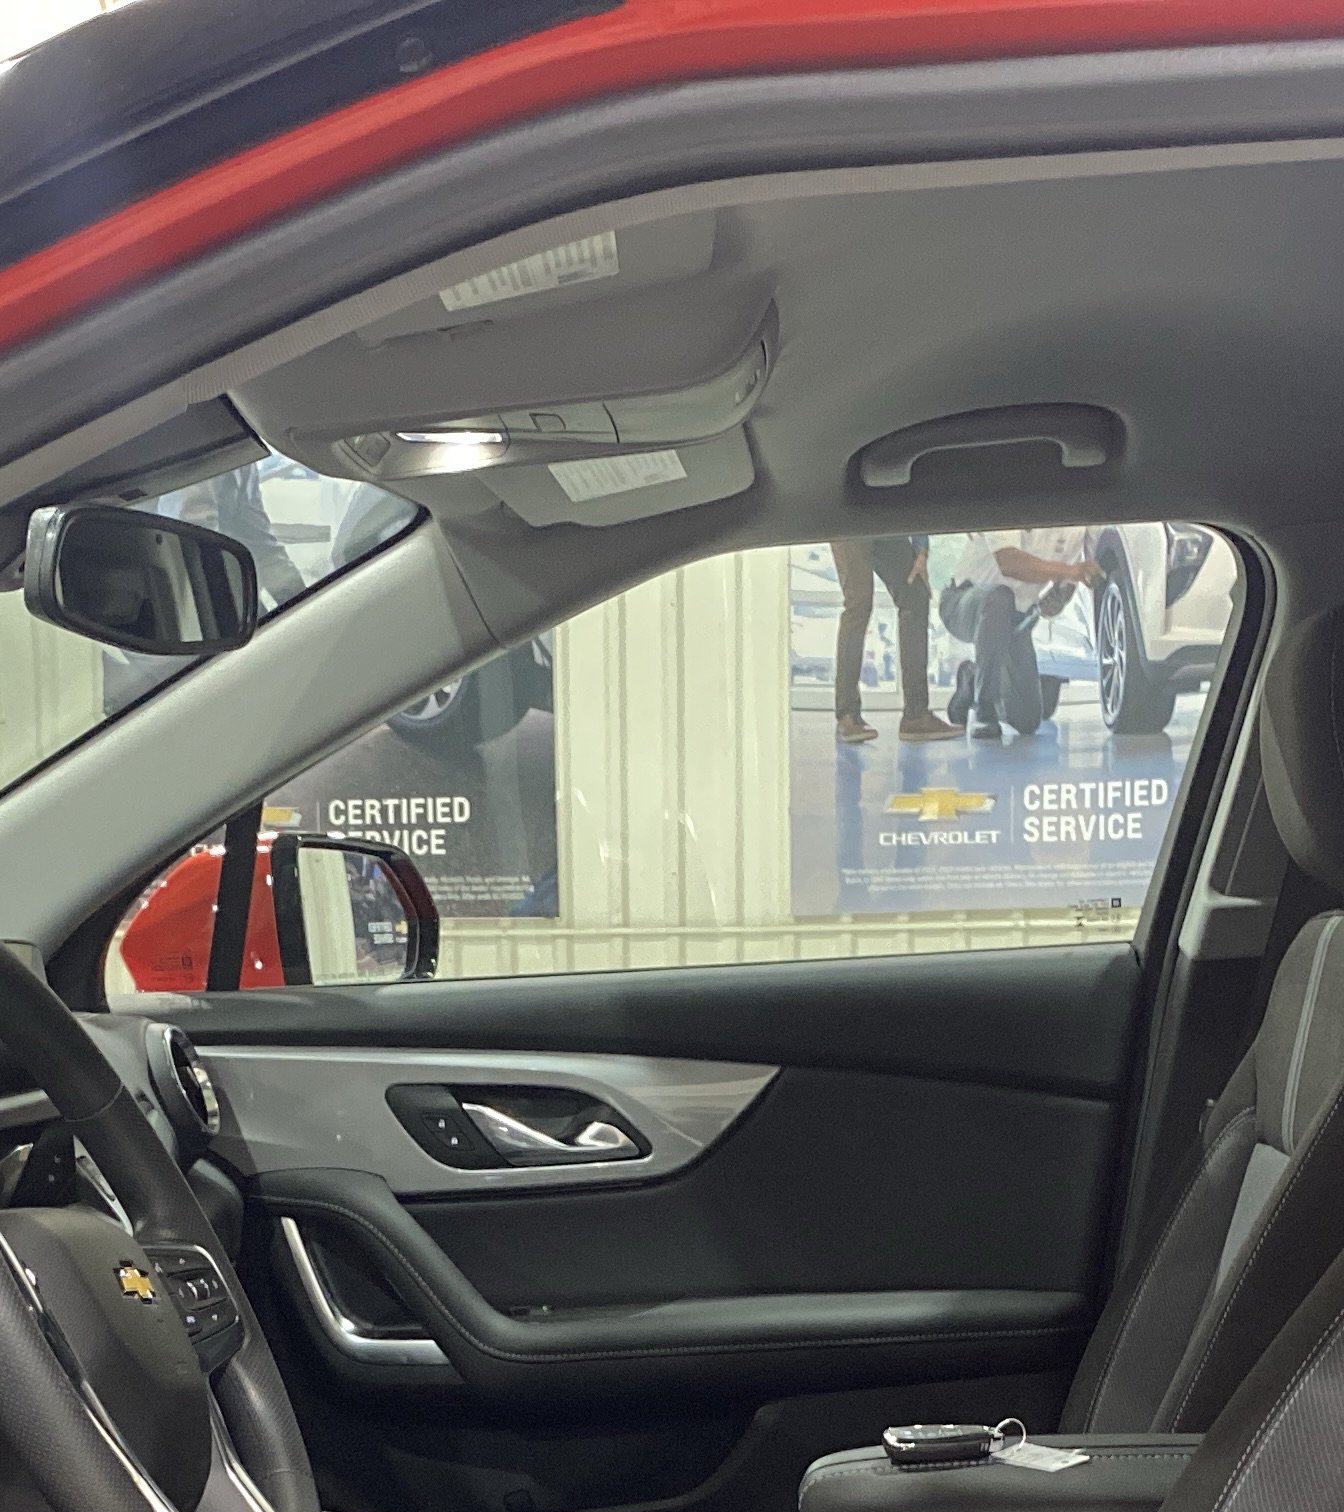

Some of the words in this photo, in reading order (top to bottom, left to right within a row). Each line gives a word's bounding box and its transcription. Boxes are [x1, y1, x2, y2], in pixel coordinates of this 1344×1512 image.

[1023, 779, 1168, 811] CERTIFIED
[328, 797, 471, 825] CERTIFIED
[879, 830, 1001, 846] CHEVROLET
[1023, 813, 1143, 844] SERVICE
